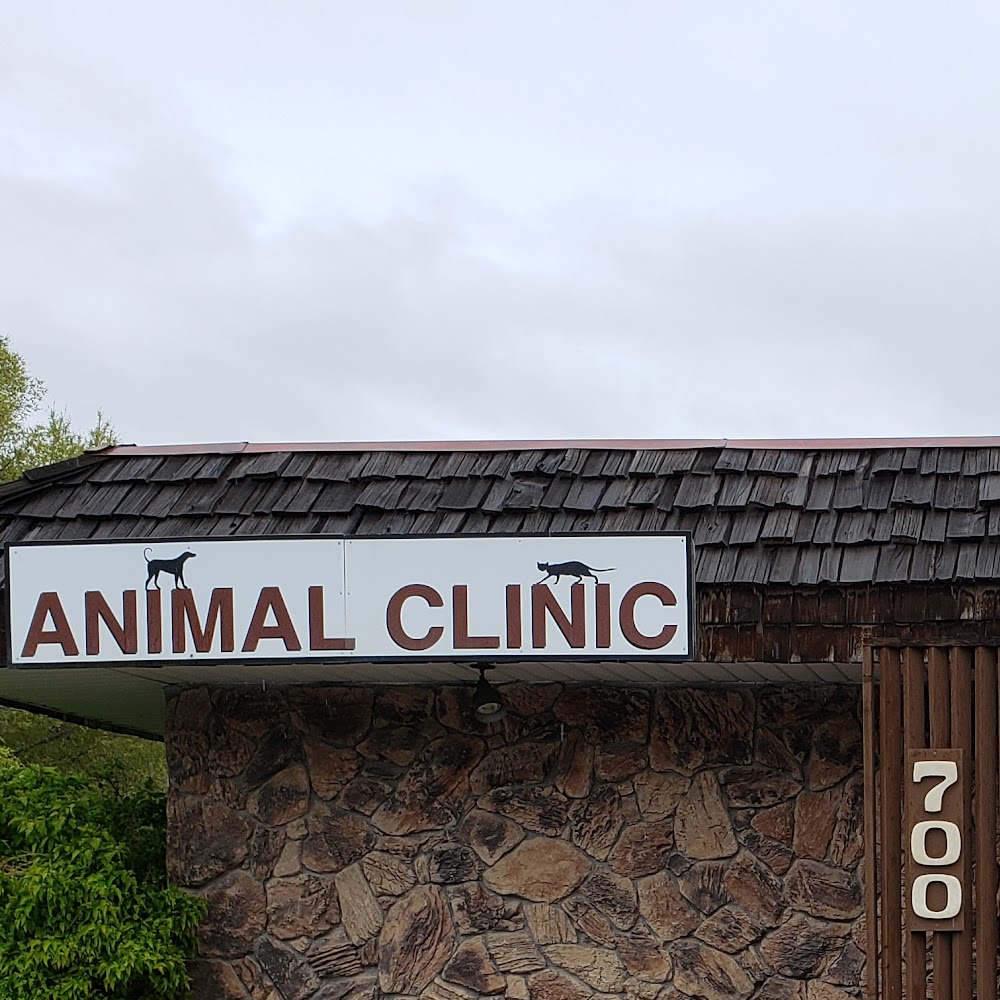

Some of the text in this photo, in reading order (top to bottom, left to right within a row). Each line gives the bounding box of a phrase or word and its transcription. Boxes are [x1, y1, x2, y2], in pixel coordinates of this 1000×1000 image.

[20, 581, 679, 658] ANIMAL CLINIC
[911, 760, 962, 919] 700
